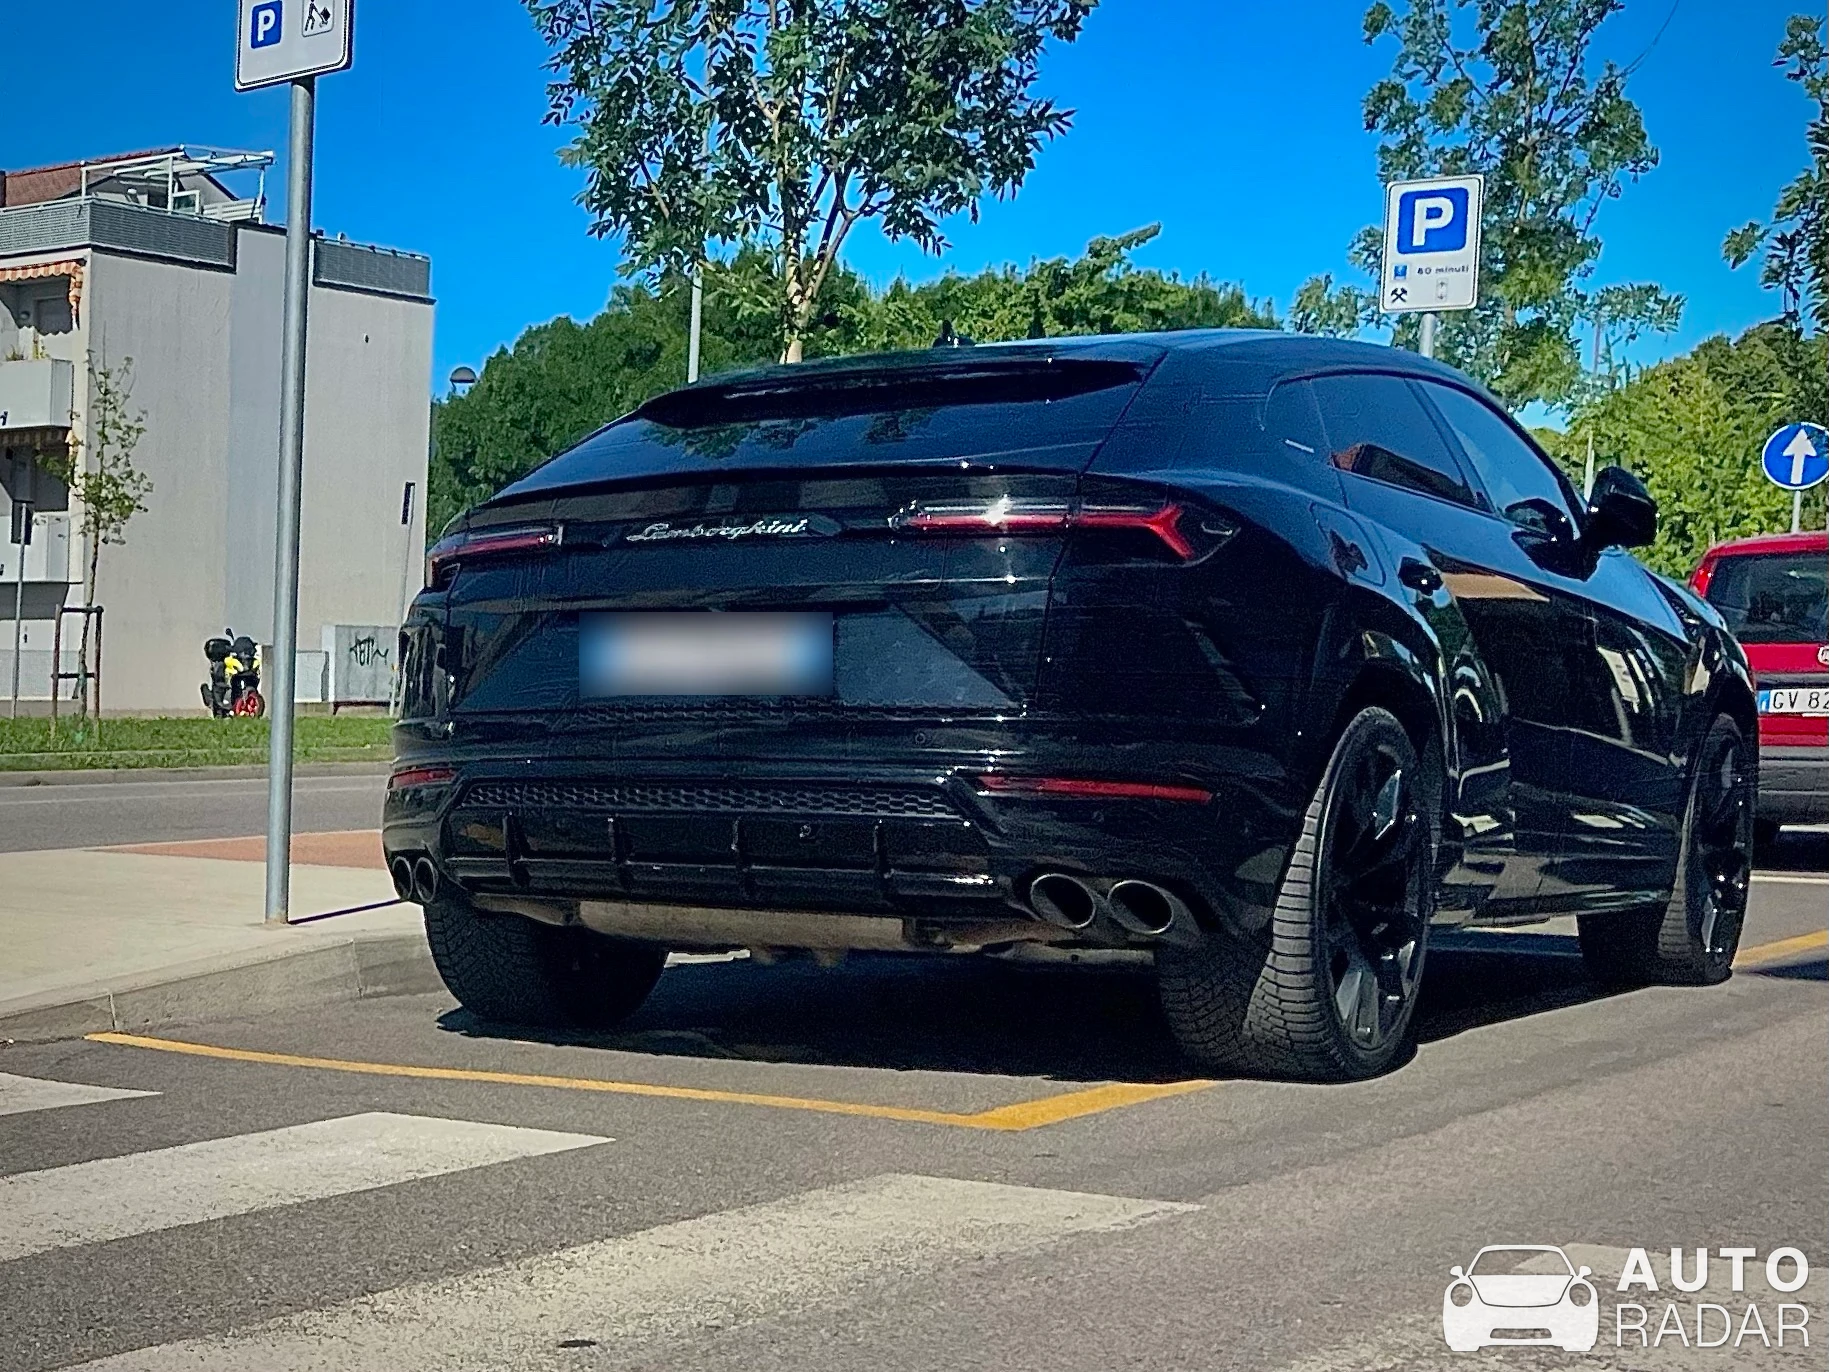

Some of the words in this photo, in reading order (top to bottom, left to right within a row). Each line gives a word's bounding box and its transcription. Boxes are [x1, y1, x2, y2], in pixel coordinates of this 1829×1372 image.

[257, 9, 276, 42] P
[1412, 196, 1454, 247] P
[626, 519, 808, 540] Lamborghini
[1773, 691, 1799, 709] GV
